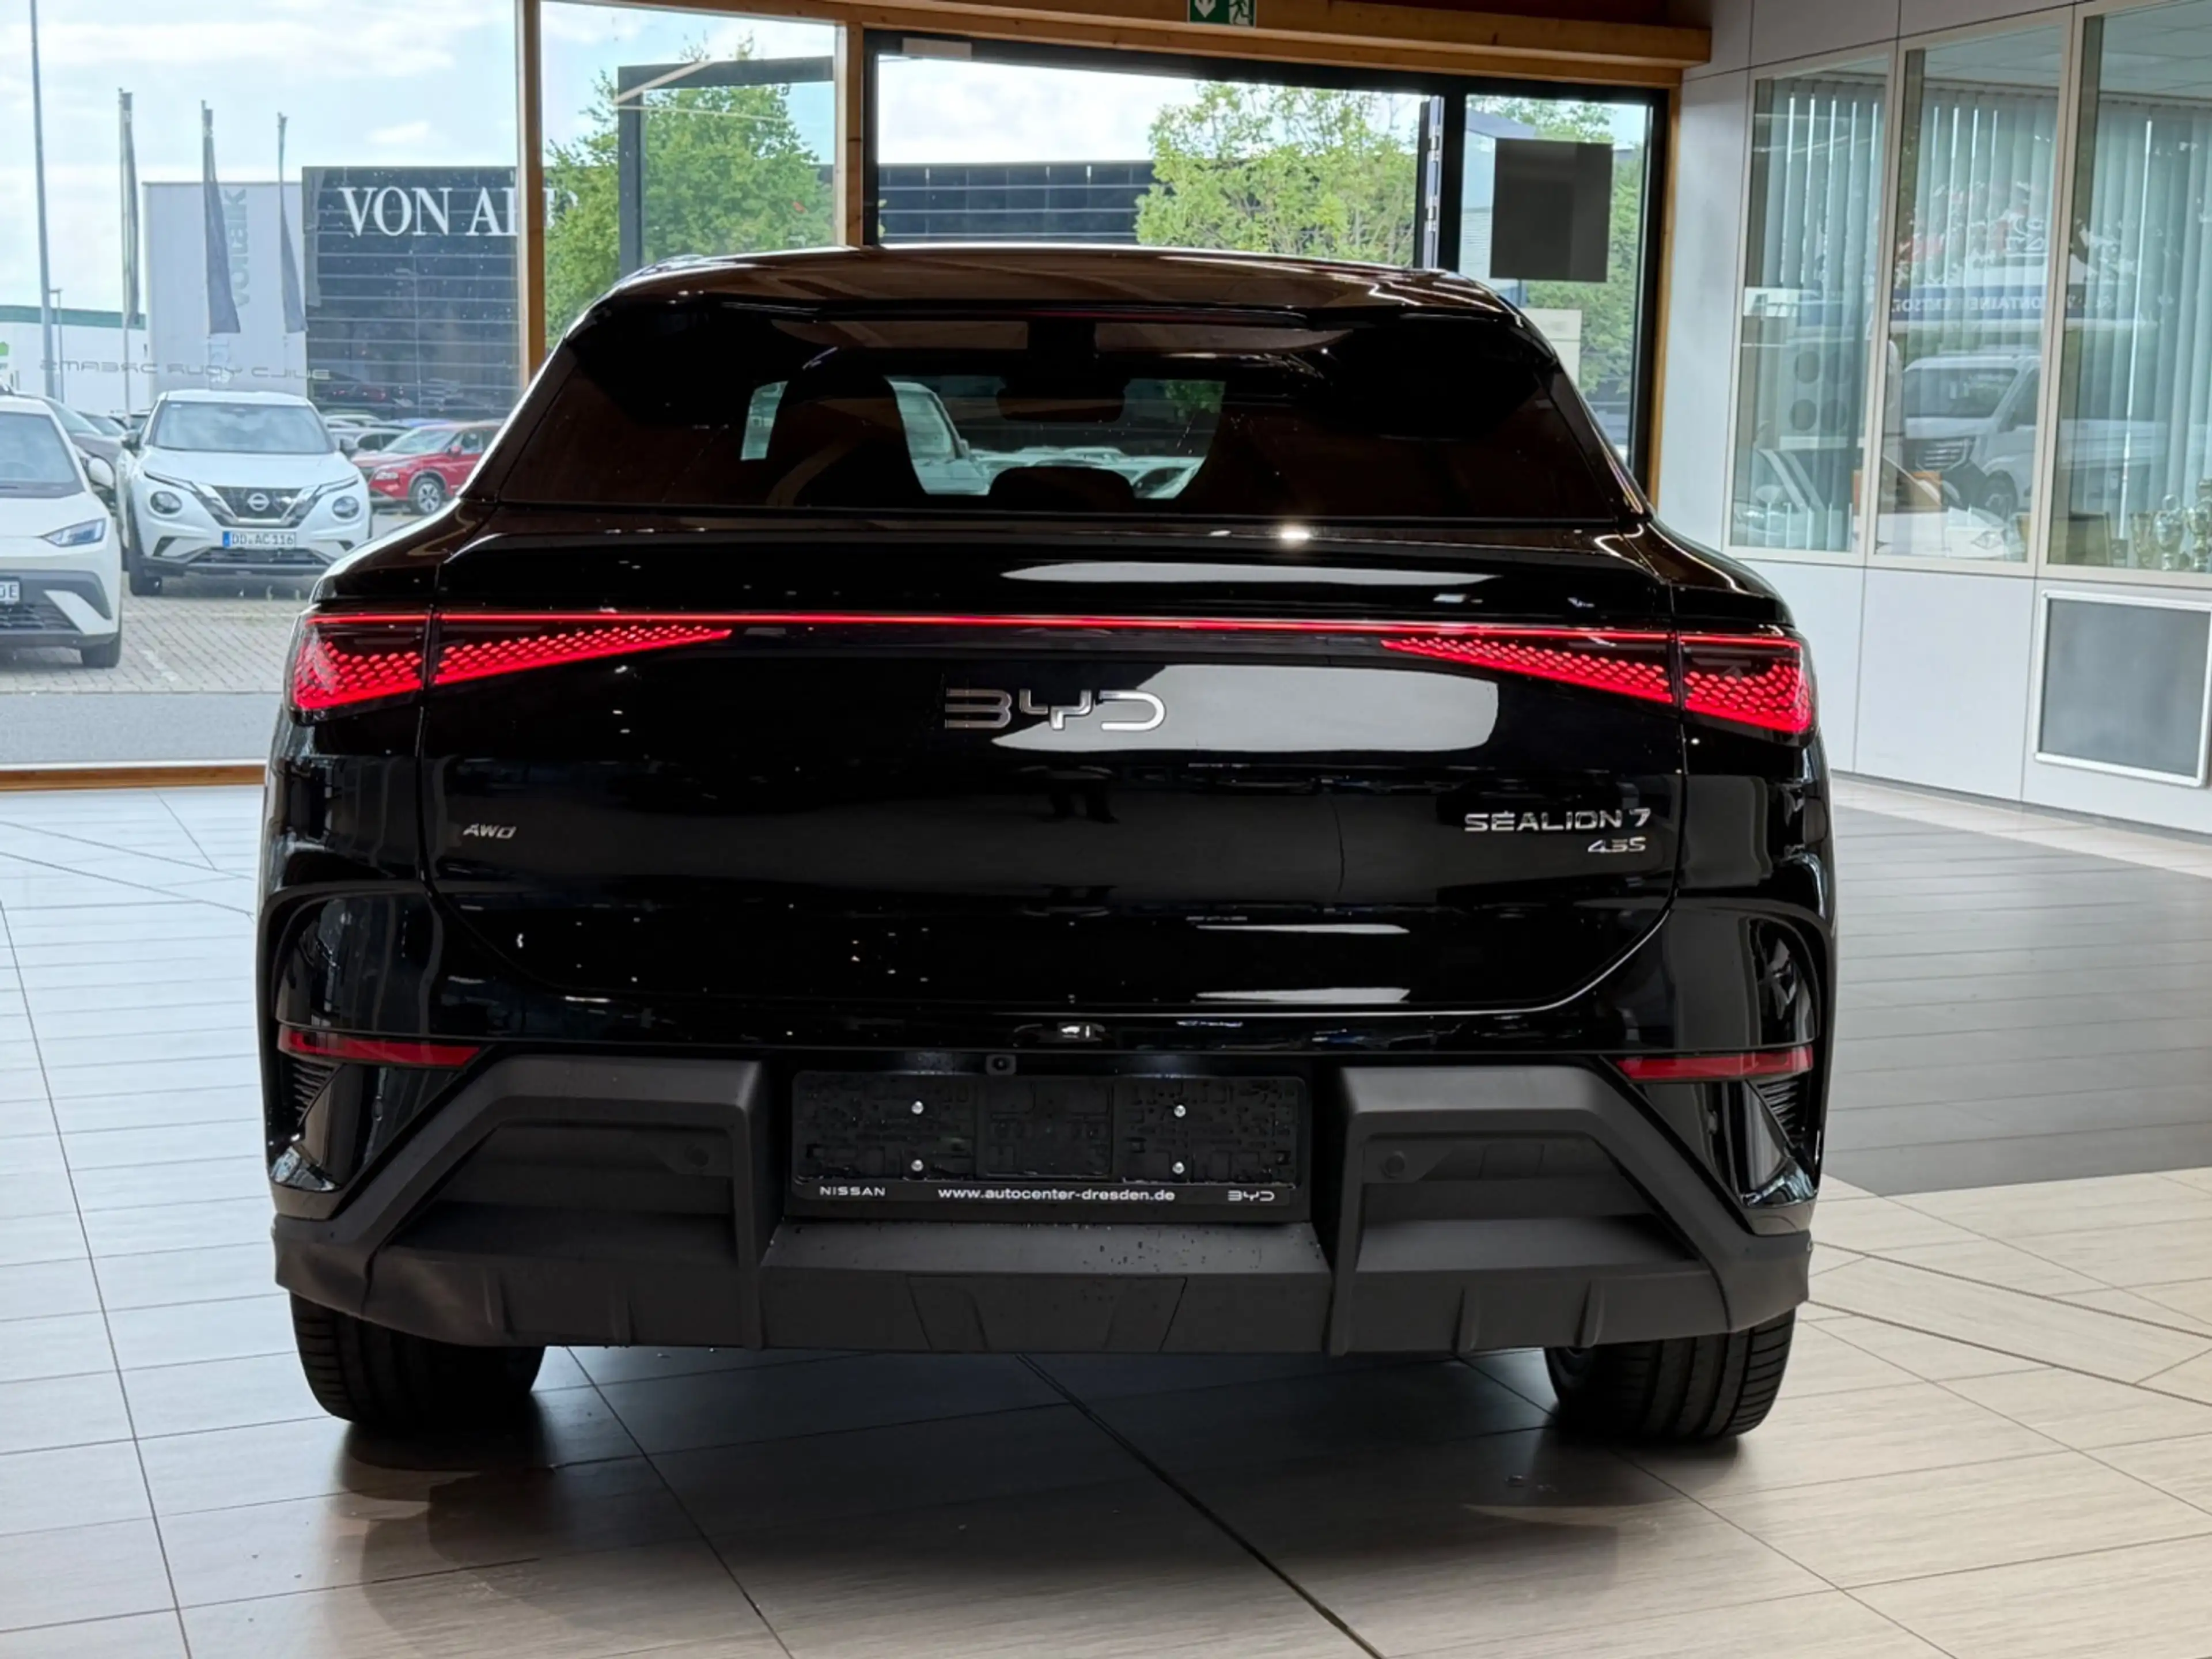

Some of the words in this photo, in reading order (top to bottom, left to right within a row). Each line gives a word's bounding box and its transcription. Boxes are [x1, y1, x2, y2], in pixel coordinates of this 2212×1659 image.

[338, 185, 453, 237] VON
[945, 688, 1166, 730] BYD
[1464, 809, 1623, 831] SEALION
[1628, 808, 1652, 827] 7
[463, 823, 517, 839] AWD
[819, 1185, 886, 1197] NISSAN
[937, 1187, 1176, 1202] www.autocenter-dresden.de
[1227, 1190, 1275, 1202] BYD
